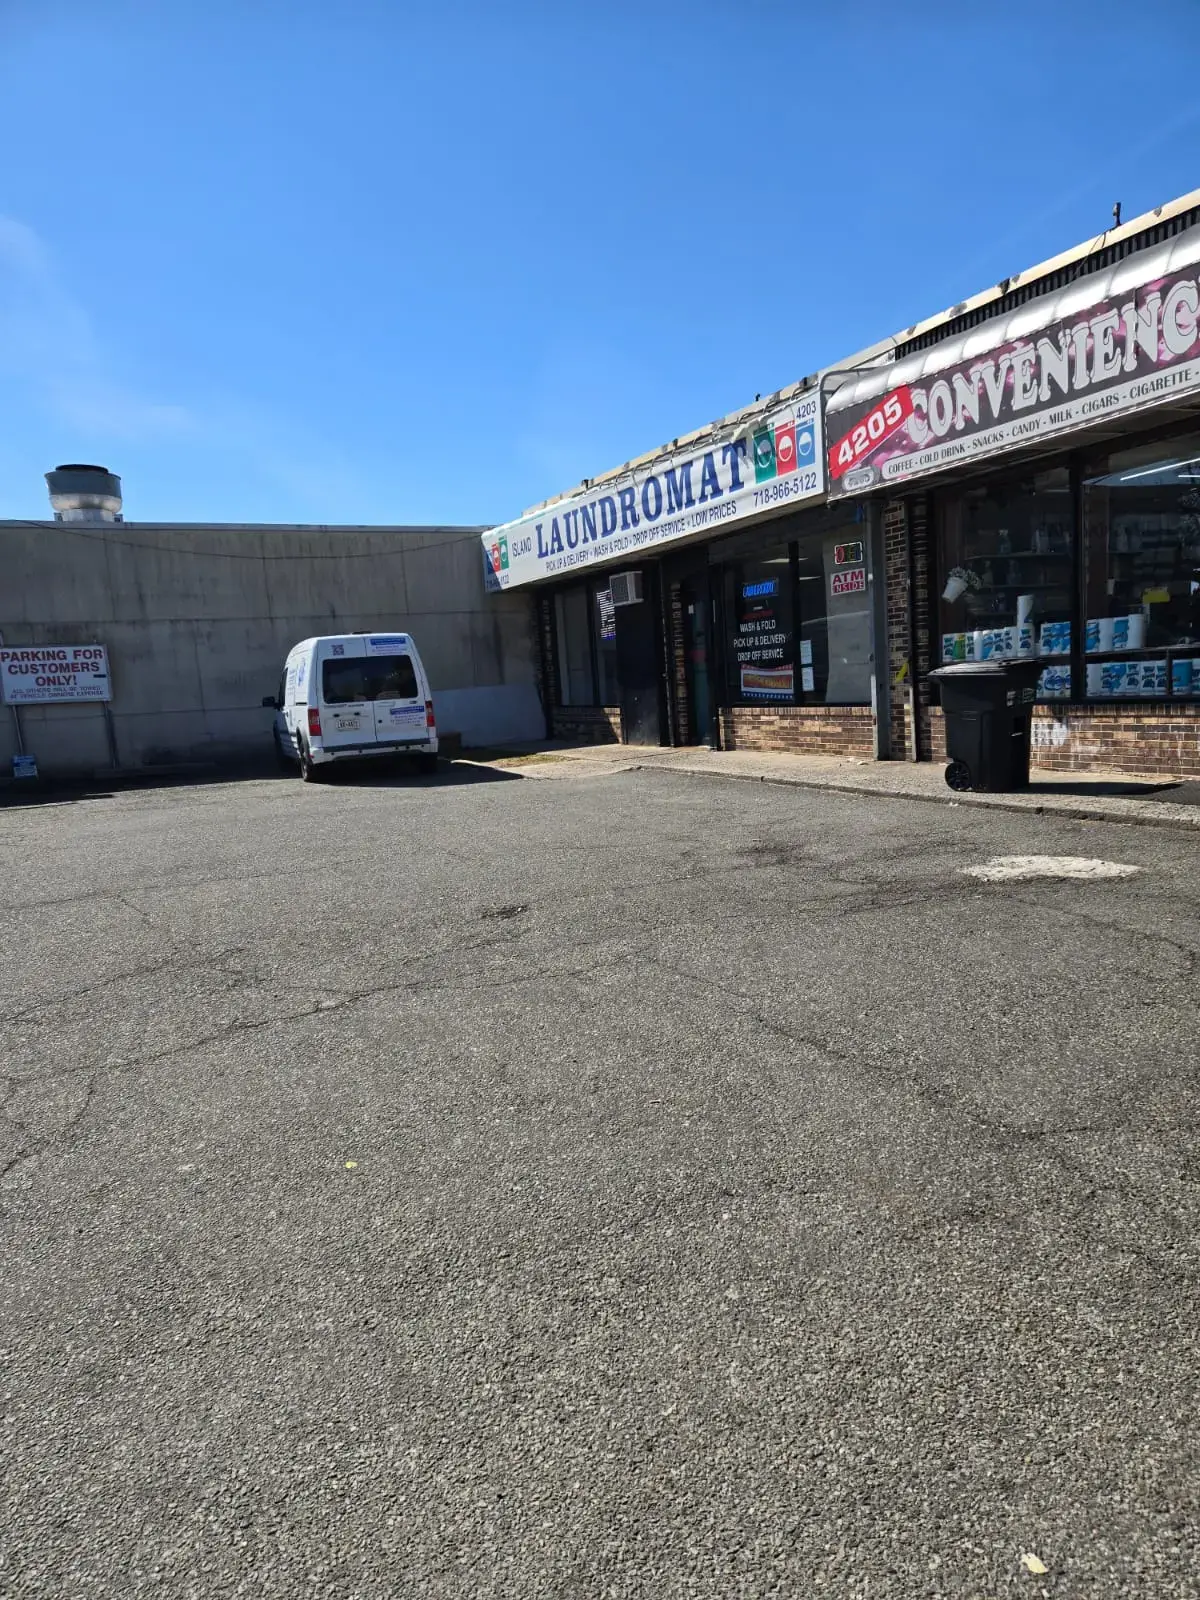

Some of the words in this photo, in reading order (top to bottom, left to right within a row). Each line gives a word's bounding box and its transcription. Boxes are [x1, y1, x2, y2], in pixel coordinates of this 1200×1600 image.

[907, 278, 1200, 446] CONVENIENC
[796, 401, 817, 419] 4203
[888, 460, 912, 474] COFFEE
[919, 452, 939, 465] COLD
[941, 446, 965, 461] DRINK
[972, 432, 1004, 450] SNACKS
[1012, 419, 1041, 437] CANDY
[1048, 408, 1073, 425] MILK
[1082, 393, 1120, 415] CIGARS
[1129, 368, 1192, 398] CIGARETTE
[838, 395, 902, 466] 4205
[753, 472, 817, 508] 718-966-5122
[512, 537, 532, 557] ISLAND
[535, 438, 747, 558] LAUNDROMAT
[546, 560, 556, 572] PICK
[556, 559, 563, 570] UP
[567, 551, 589, 567] DELIVERY
[593, 541, 608, 557] WASH
[614, 536, 629, 552] FOLD
[633, 529, 647, 548] DROP
[648, 526, 660, 541] OFF
[660, 518, 686, 538] SERVICE
[691, 512, 708, 528] LOW
[710, 500, 737, 521] PRICES
[833, 570, 864, 584] ATM
[833, 581, 864, 593] INSIDE
[740, 622, 755, 633] WASH
[761, 619, 776, 630] FOLD
[733, 638, 745, 648] PICK
[746, 638, 754, 647] UP
[759, 633, 786, 646] DELIVERY
[0, 650, 67, 662] PARKING
[73, 649, 103, 660] FOR
[737, 652, 751, 662] DROP
[751, 651, 761, 661] OFF
[762, 648, 784, 660] SERVICE
[8, 662, 100, 675] CUSTOMERS
[35, 675, 78, 686] ONLY!
